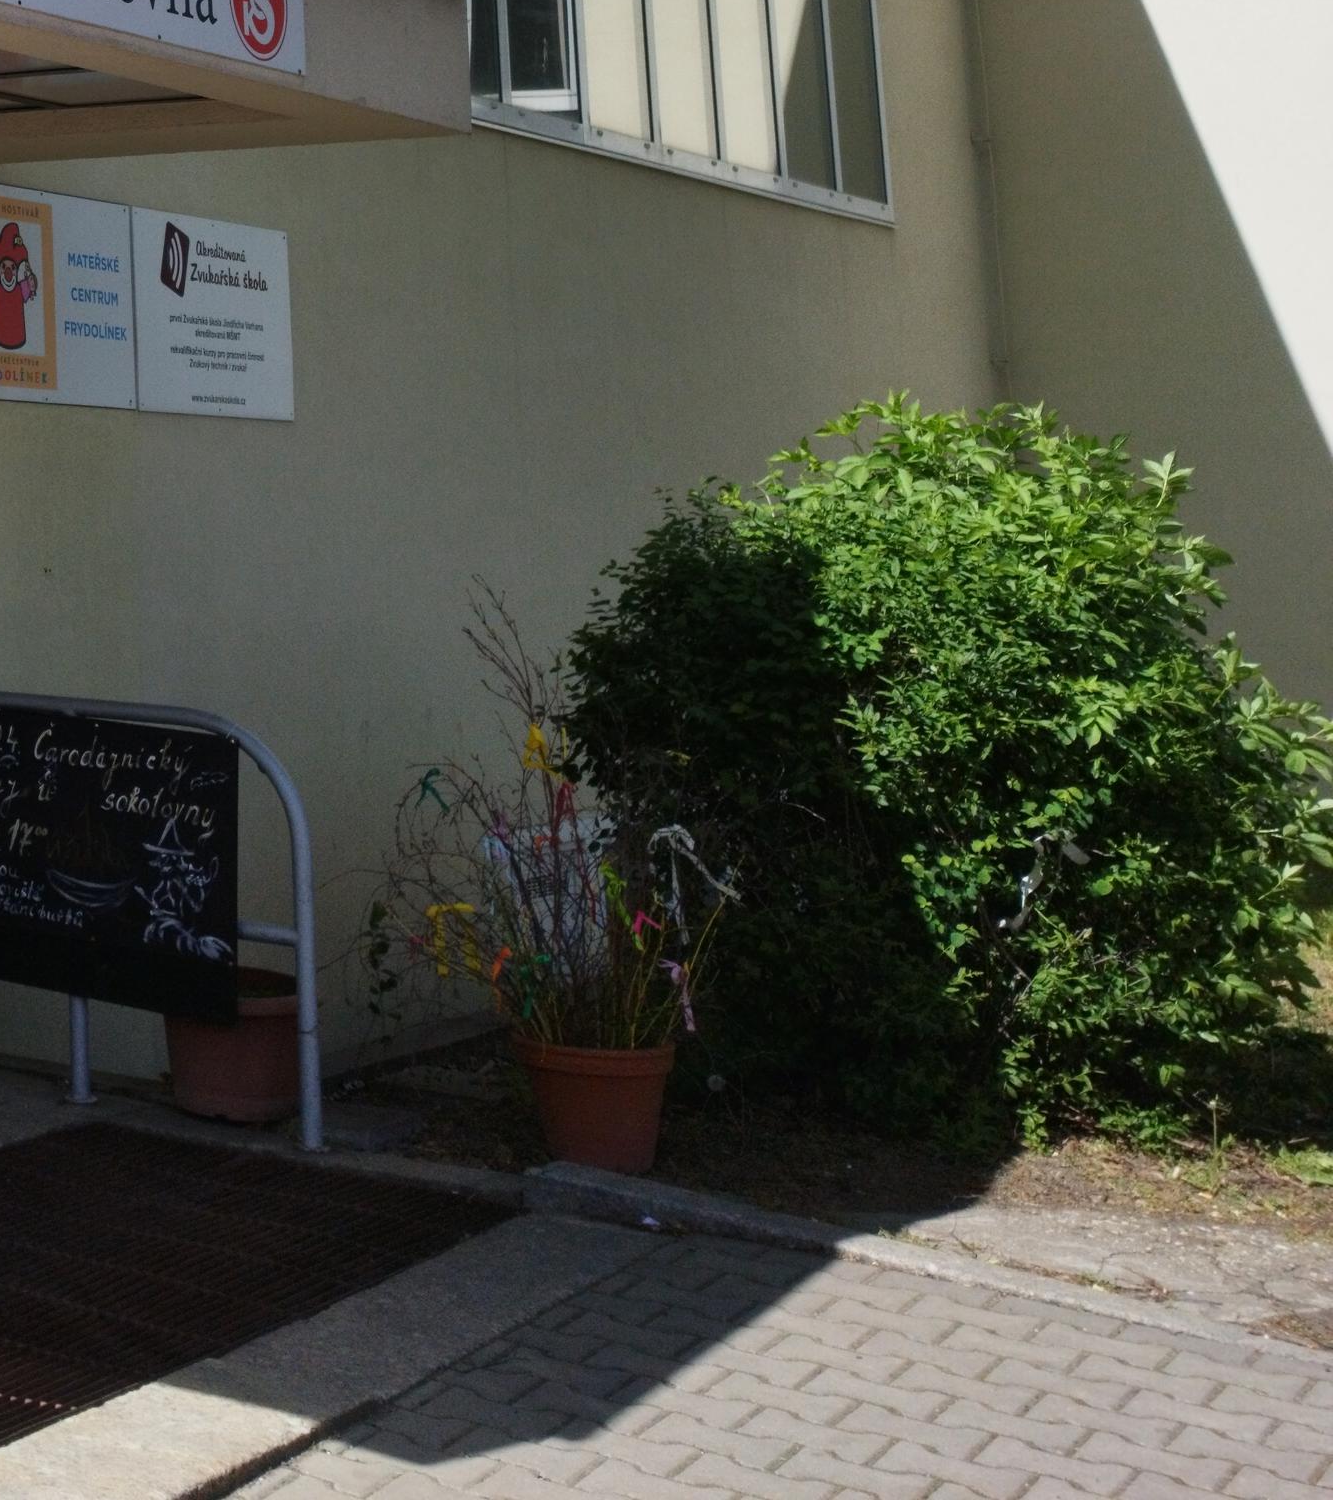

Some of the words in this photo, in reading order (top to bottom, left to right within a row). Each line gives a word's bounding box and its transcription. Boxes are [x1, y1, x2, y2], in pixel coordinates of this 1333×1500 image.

[67, 252, 120, 273] MATEŘSKÉ
[190, 263, 241, 288] Zvukařská
[243, 269, 269, 292] škola
[71, 287, 119, 307] CENTRUM
[64, 321, 128, 342] FRYDOLÍNEK
